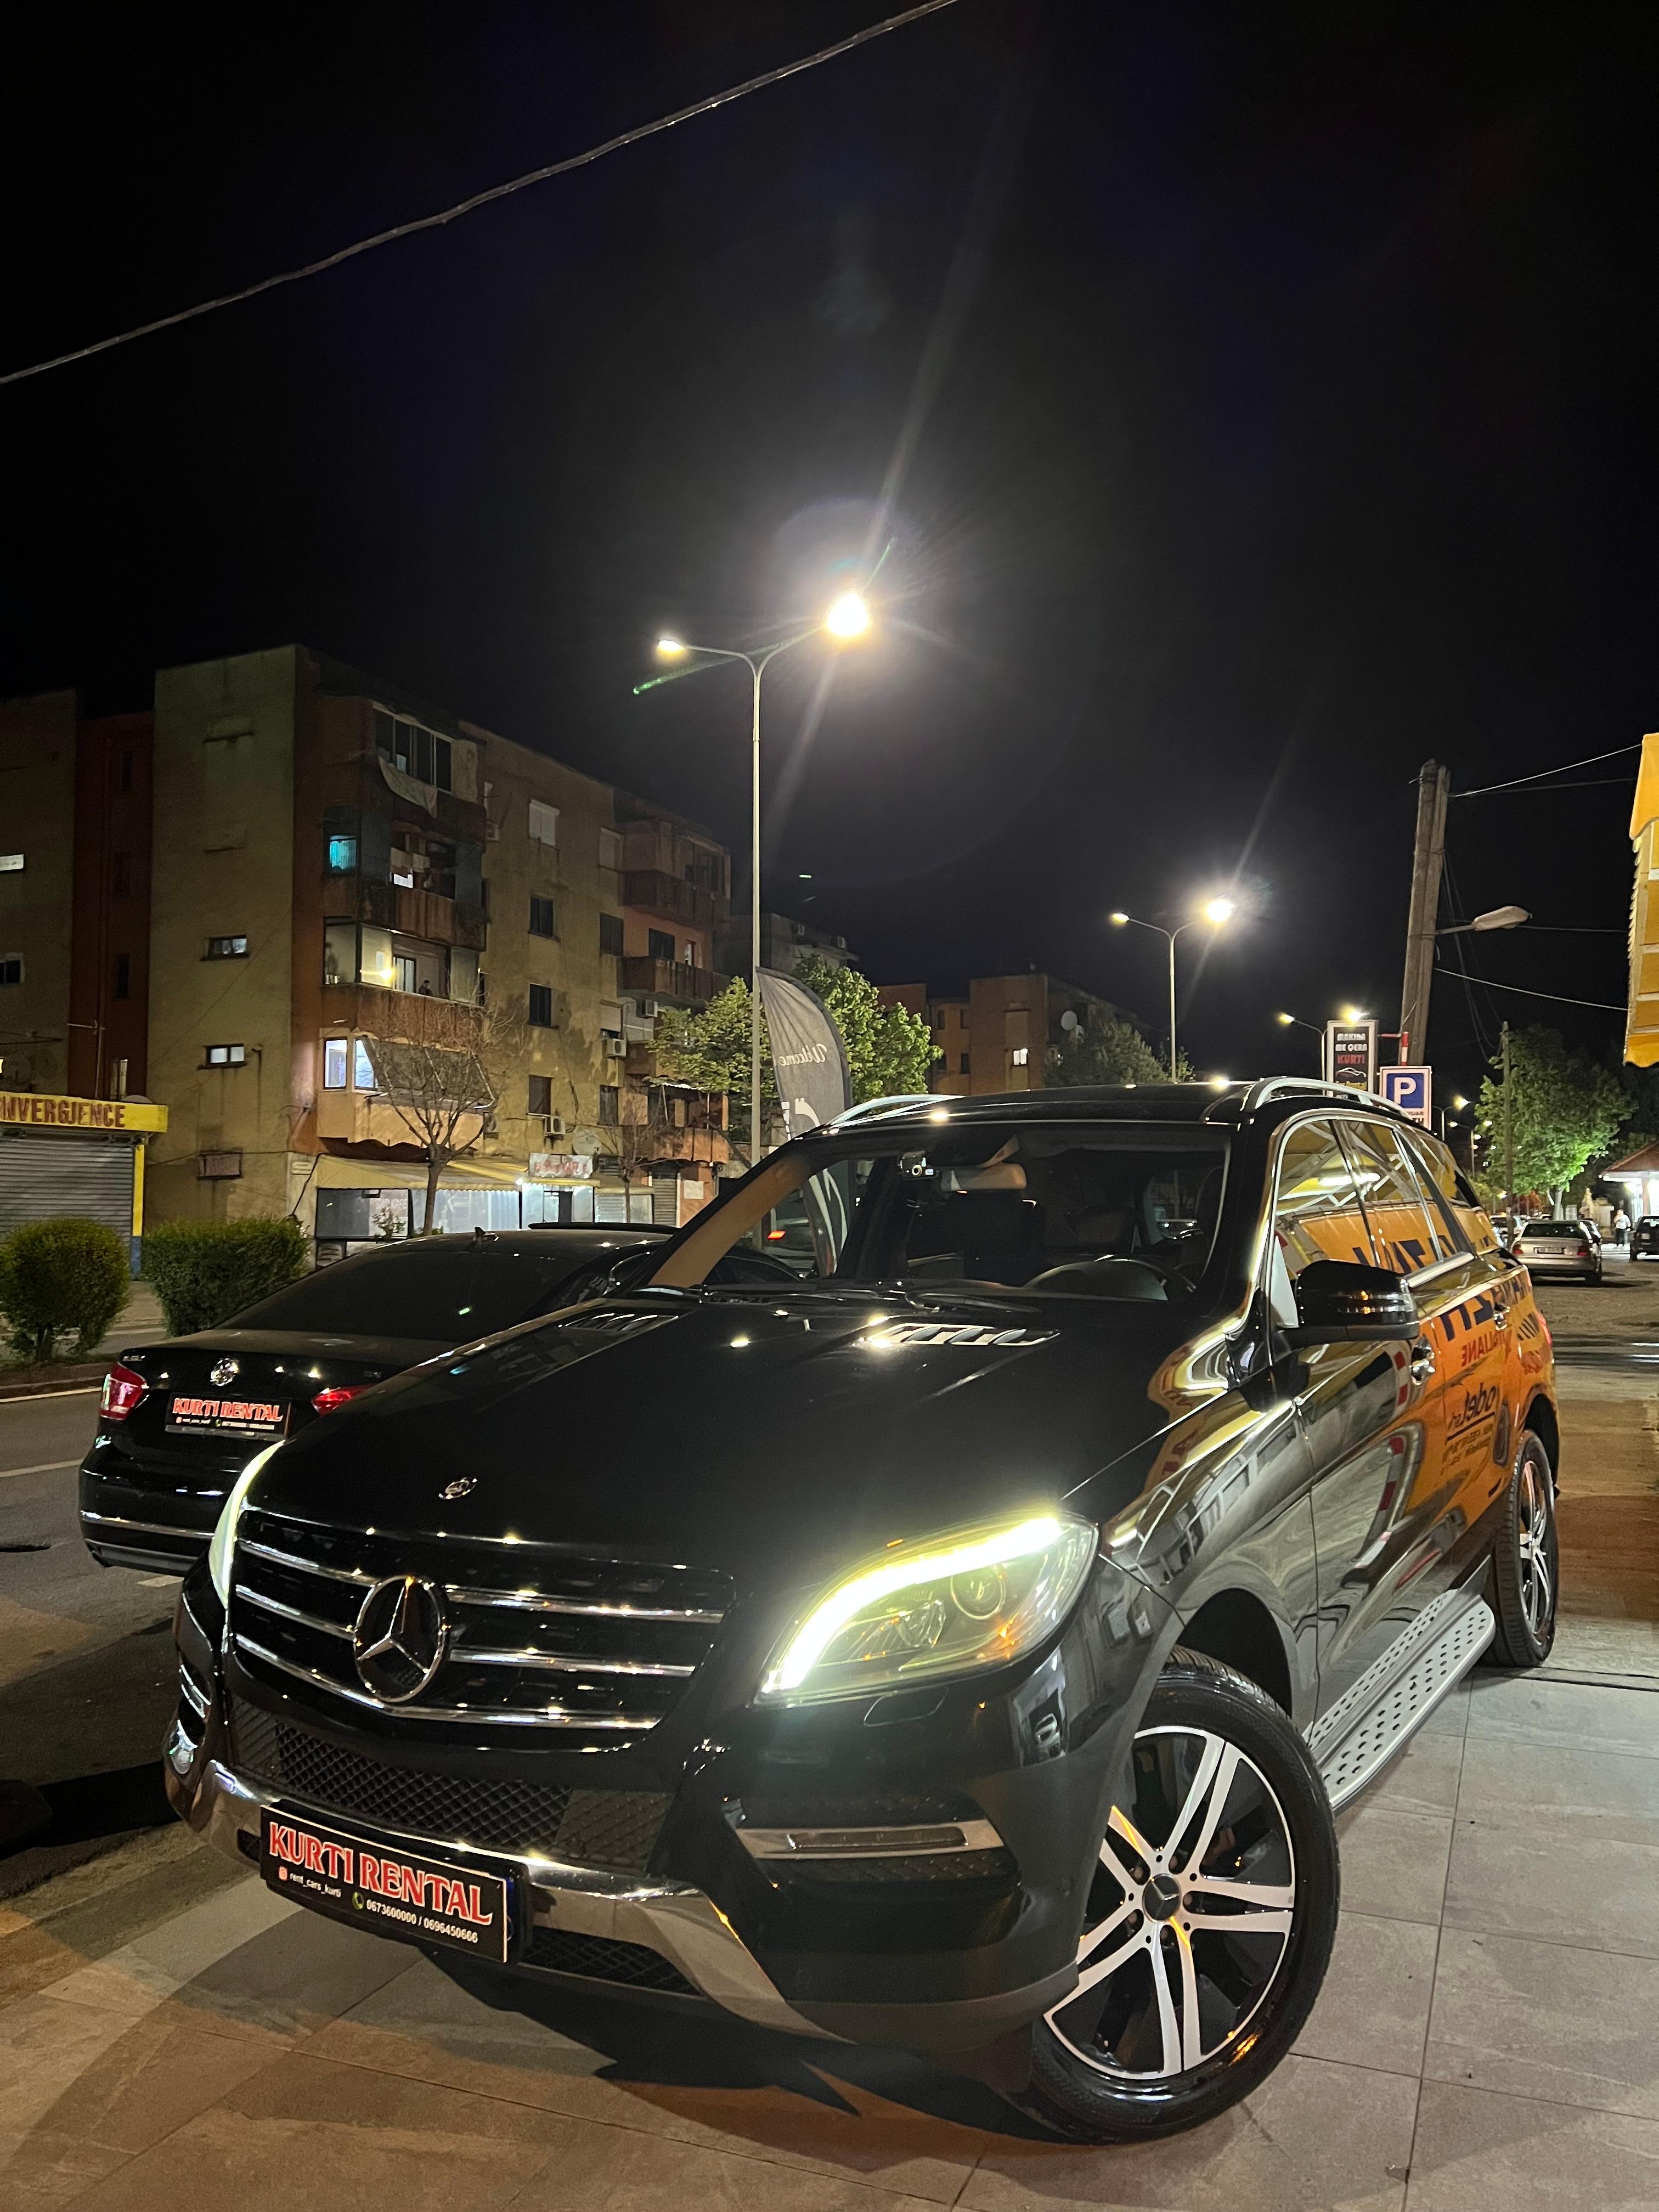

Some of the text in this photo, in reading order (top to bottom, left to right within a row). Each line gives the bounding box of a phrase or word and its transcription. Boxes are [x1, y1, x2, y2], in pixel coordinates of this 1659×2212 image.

[1337, 1054, 1365, 1064] KURTI
[1394, 1077, 1417, 1104] P
[0, 1094, 126, 1128] NVERGJENCE
[172, 1398, 283, 1422] KURTI RENTAL
[269, 1821, 493, 1925] KURTI RENTAL
